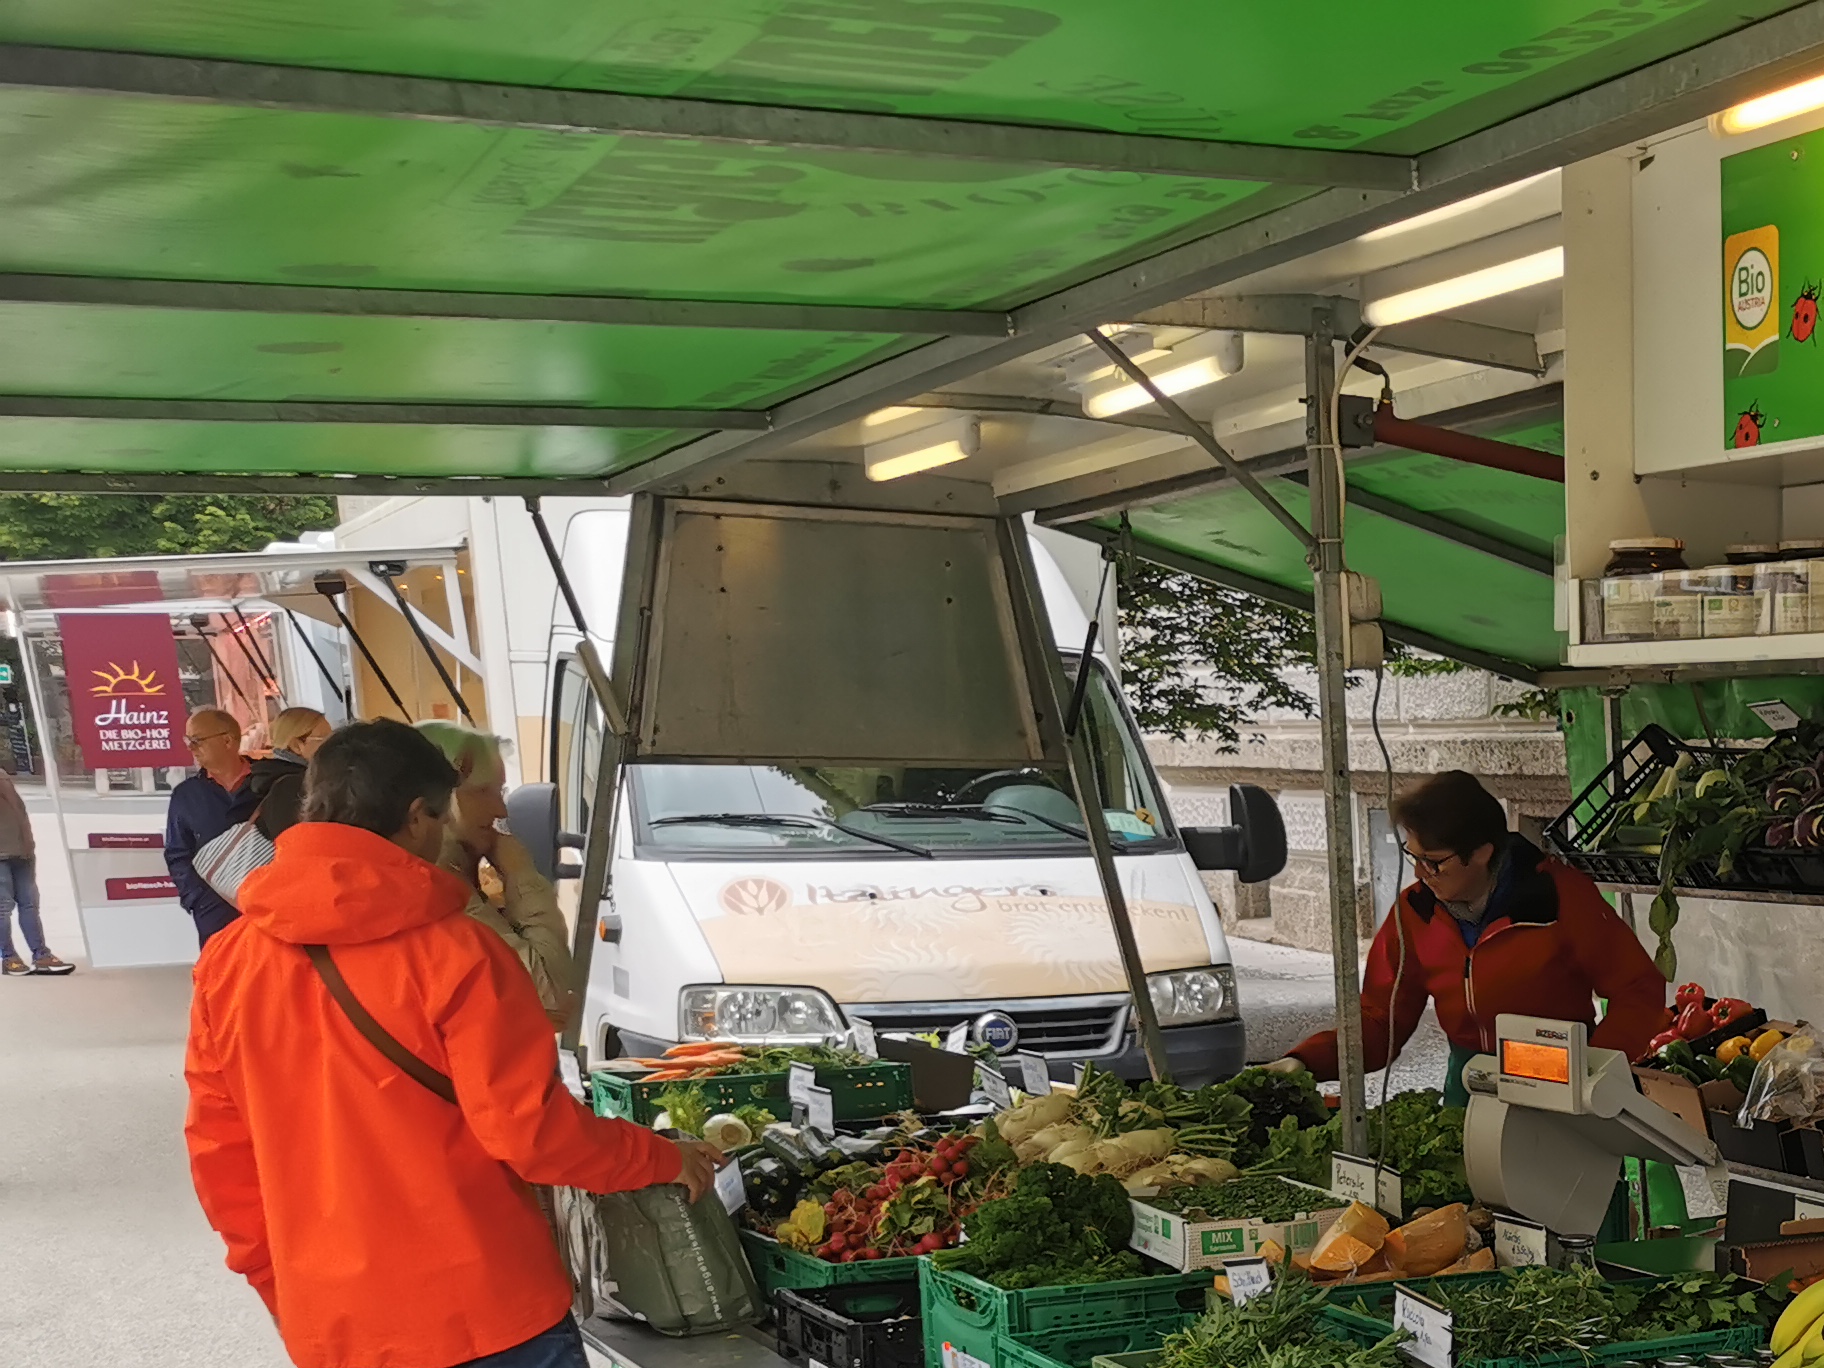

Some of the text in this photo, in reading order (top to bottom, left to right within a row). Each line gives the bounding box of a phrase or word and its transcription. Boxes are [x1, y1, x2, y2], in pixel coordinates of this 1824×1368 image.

[1738, 264, 1766, 299] Bio
[1737, 297, 1766, 313] AUSTRIA
[95, 697, 169, 727] Hainz
[99, 727, 170, 740] DIE BIO-HOF
[101, 739, 171, 752] METZGEREI
[997, 899, 1049, 914] brot
[984, 1026, 1012, 1043] FIAT
[1211, 1231, 1234, 1244] MIX
